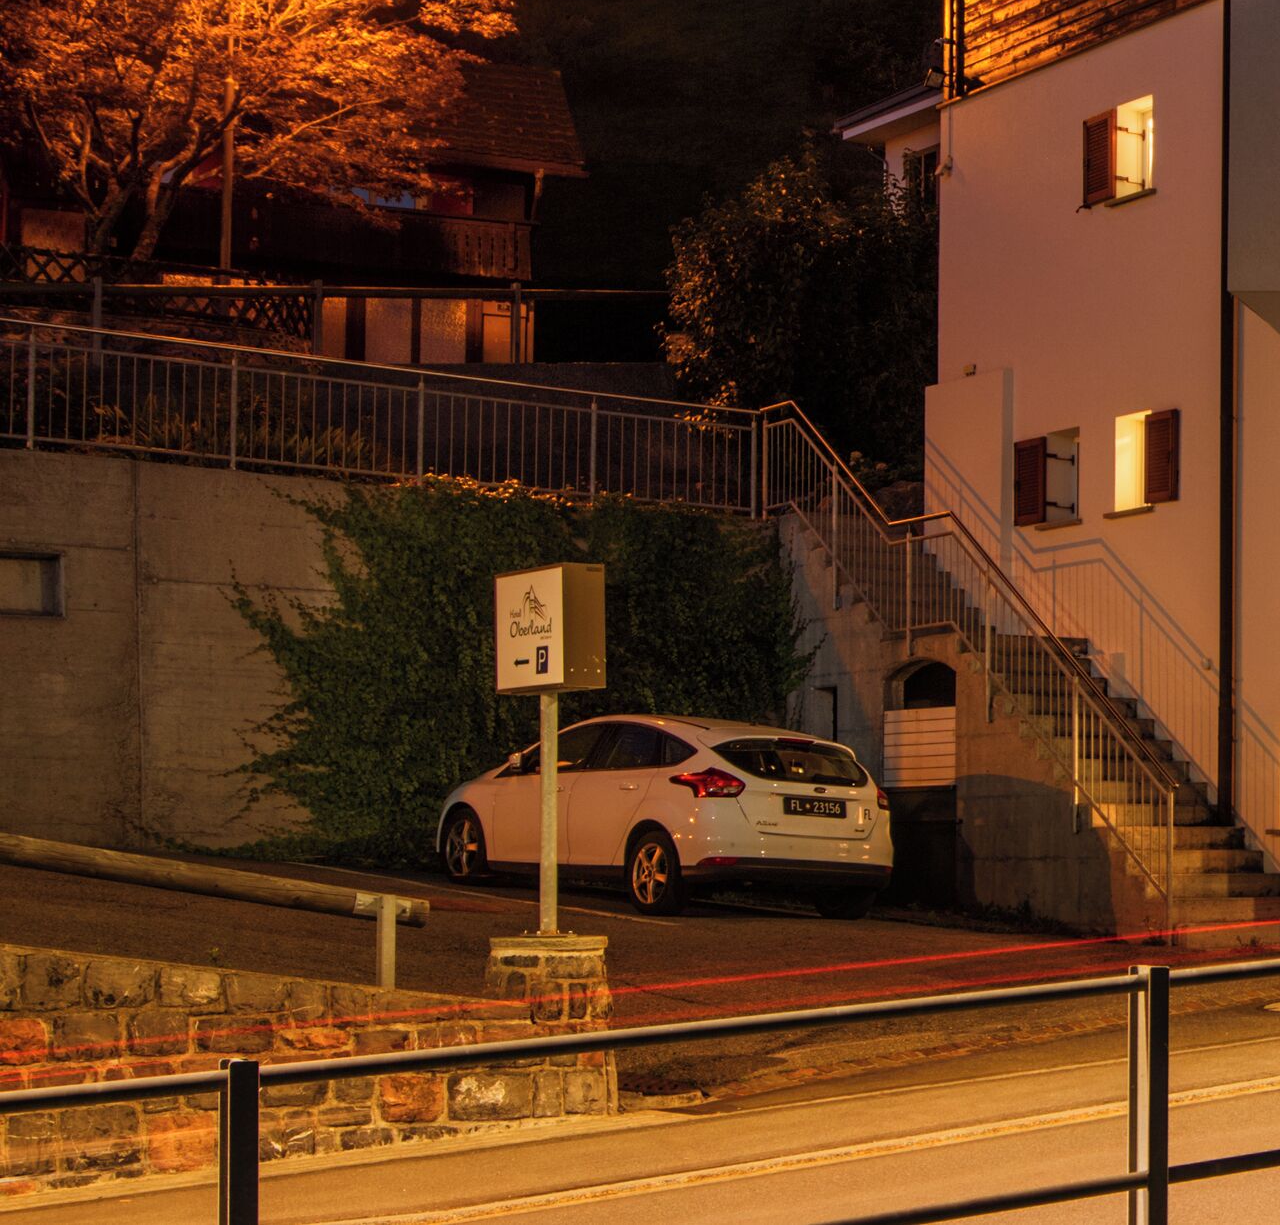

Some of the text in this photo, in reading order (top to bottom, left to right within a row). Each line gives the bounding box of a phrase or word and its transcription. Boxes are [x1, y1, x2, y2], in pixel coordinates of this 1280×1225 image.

[509, 617, 552, 638] Oberland
[538, 649, 546, 671] P
[791, 800, 841, 814] FL 23156
[864, 809, 872, 820] FL
